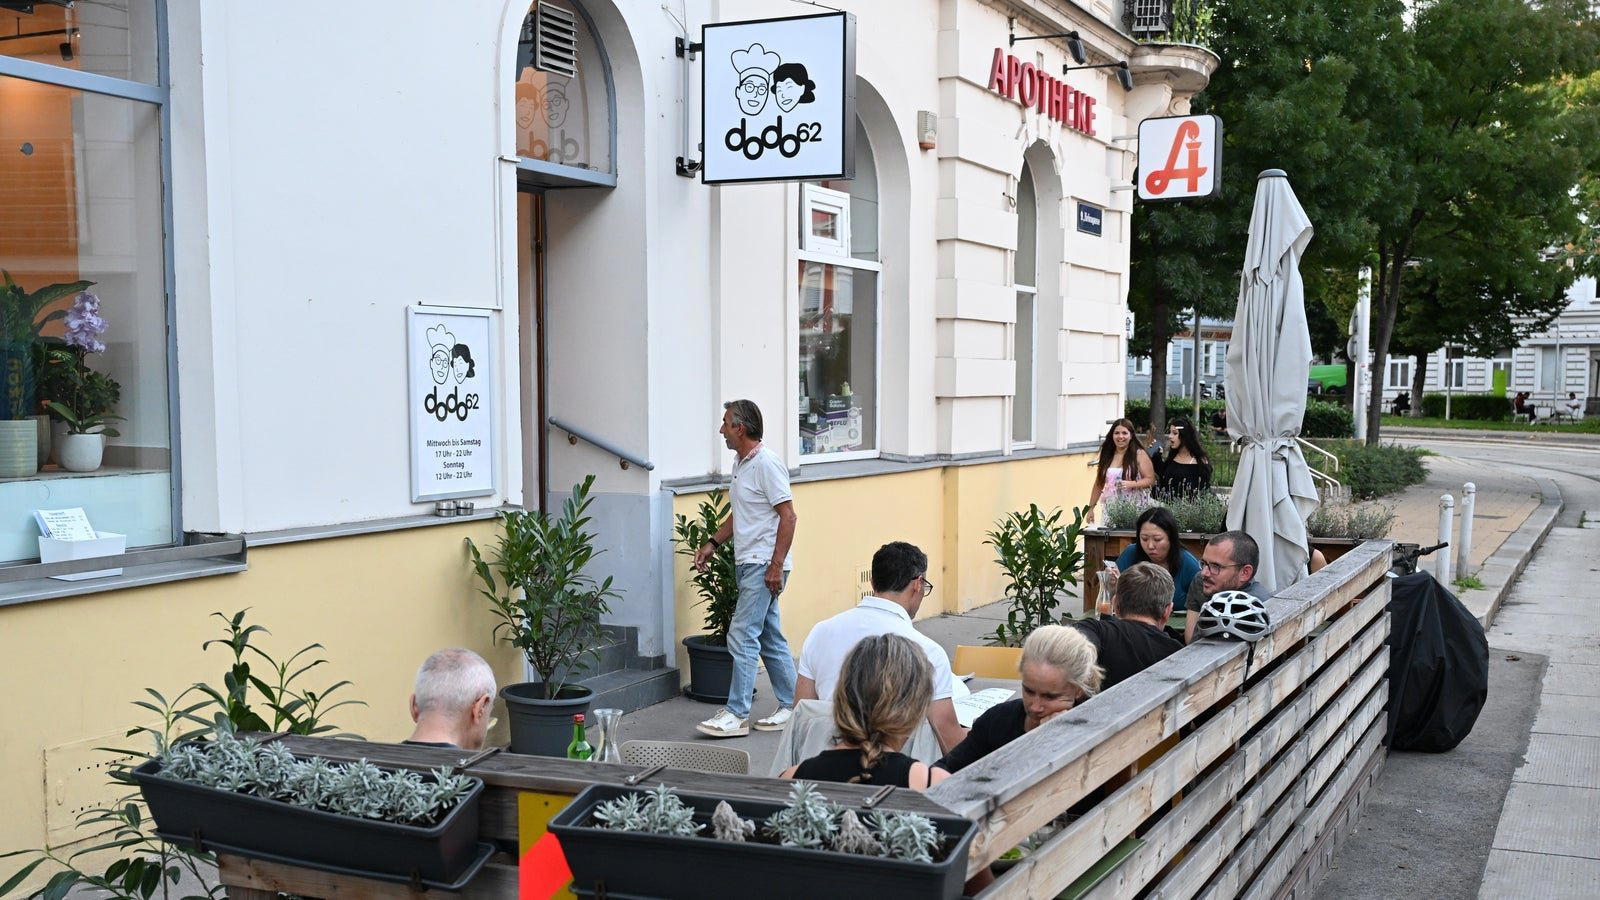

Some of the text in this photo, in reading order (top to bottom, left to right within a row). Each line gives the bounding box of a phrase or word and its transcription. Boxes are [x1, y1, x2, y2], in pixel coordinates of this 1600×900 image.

[988, 47, 1096, 136] APOTHEKE
[426, 439, 451, 447] Mittwoch
[460, 439, 481, 447] Samstag
[443, 461, 464, 469] Sonntag
